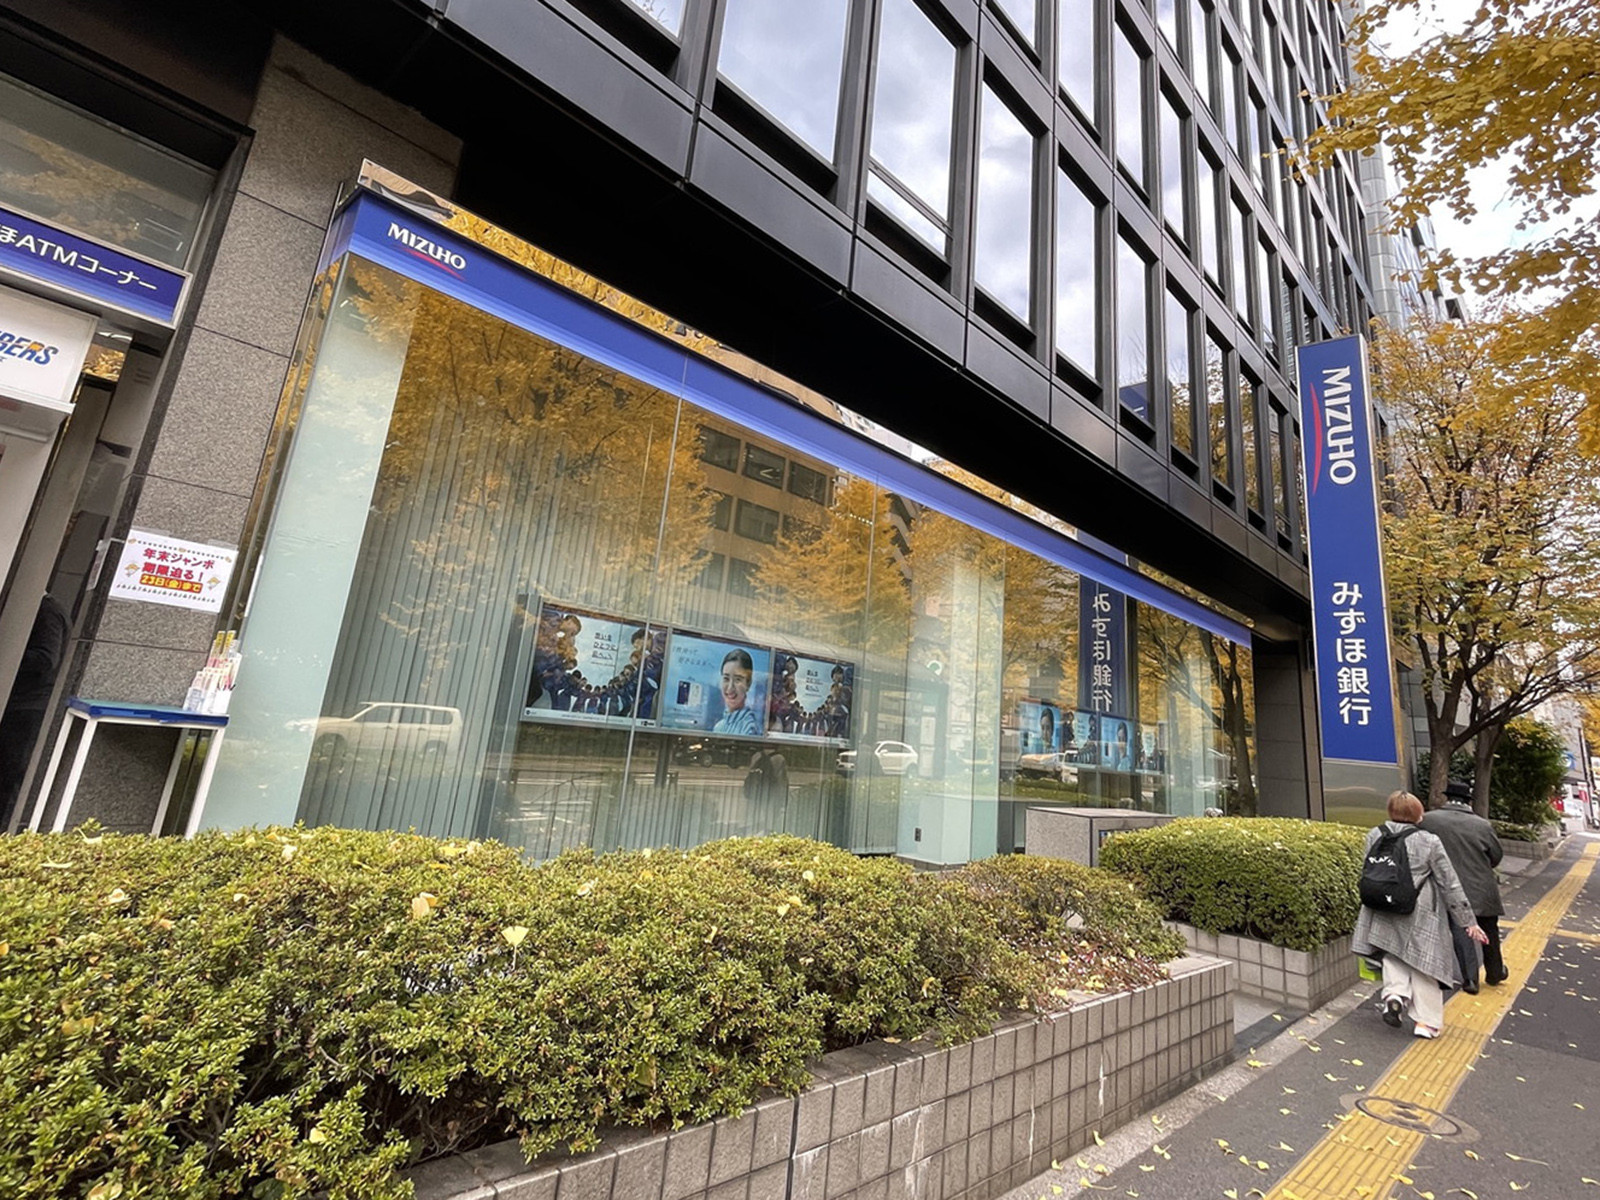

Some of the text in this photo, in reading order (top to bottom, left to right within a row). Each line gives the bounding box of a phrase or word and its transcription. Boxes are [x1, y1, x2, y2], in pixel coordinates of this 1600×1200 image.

[387, 221, 467, 271] MIZUHO
[0, 330, 60, 366] BERS
[1322, 364, 1357, 486] MIZUHO
[1331, 581, 1373, 726] みずほ銀行
